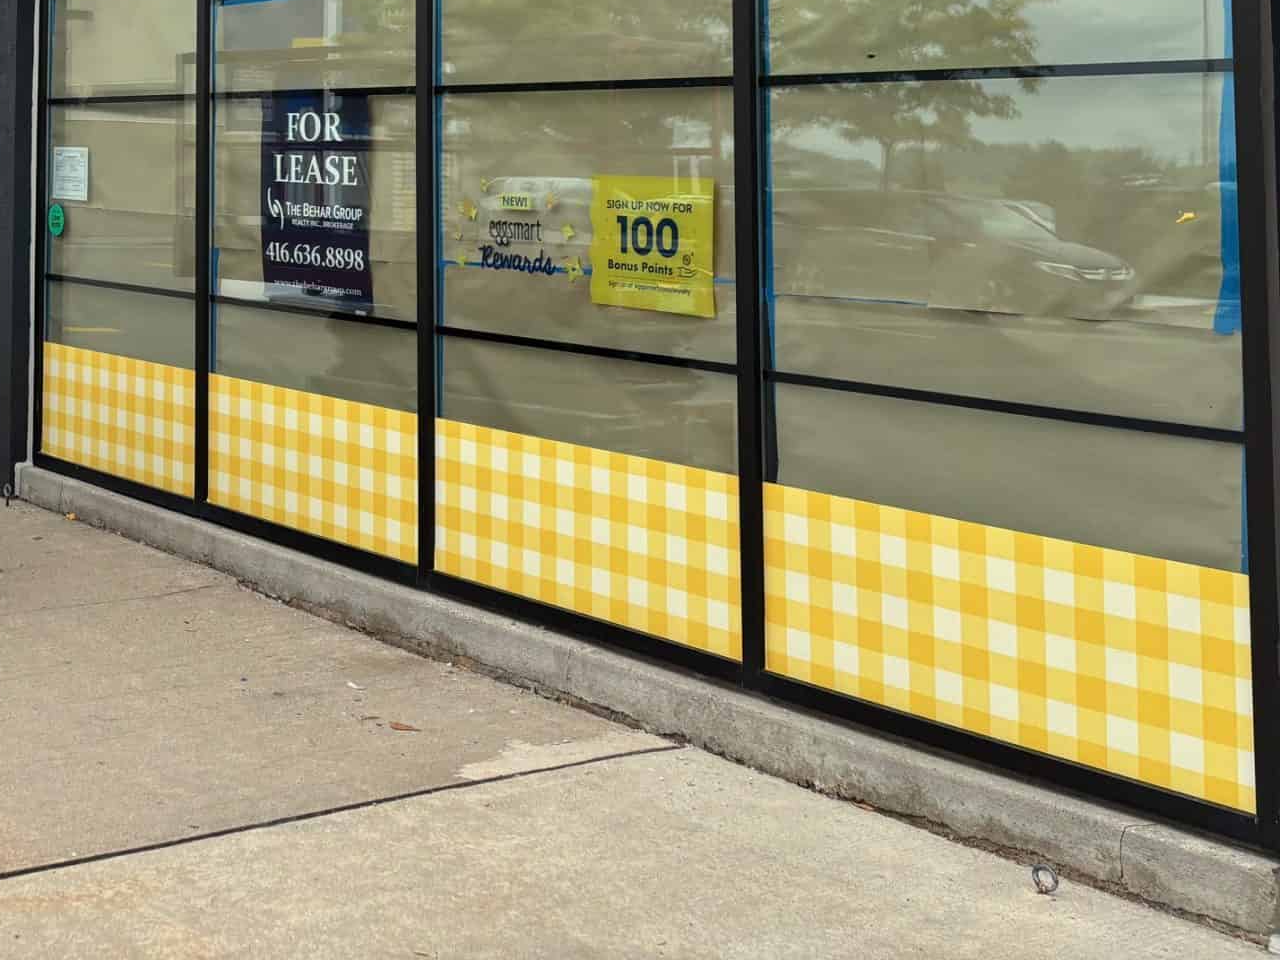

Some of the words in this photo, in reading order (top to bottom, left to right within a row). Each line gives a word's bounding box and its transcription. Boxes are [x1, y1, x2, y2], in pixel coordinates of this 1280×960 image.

[285, 111, 345, 142] FOR
[273, 153, 358, 186] LEASE
[285, 201, 302, 217] THE
[302, 202, 331, 218] BEHAR
[333, 204, 363, 221] GROUP
[501, 195, 528, 208] NEW!
[606, 199, 629, 210] SIGN
[631, 200, 643, 211] UP
[645, 202, 669, 212] NOW
[672, 202, 693, 214] FOR
[488, 219, 543, 246] eggsmart
[616, 215, 679, 258] 100
[265, 240, 365, 271] 416.636.8898
[478, 244, 557, 275] Rewards
[607, 258, 639, 271] Bonus
[641, 261, 673, 276] Points
